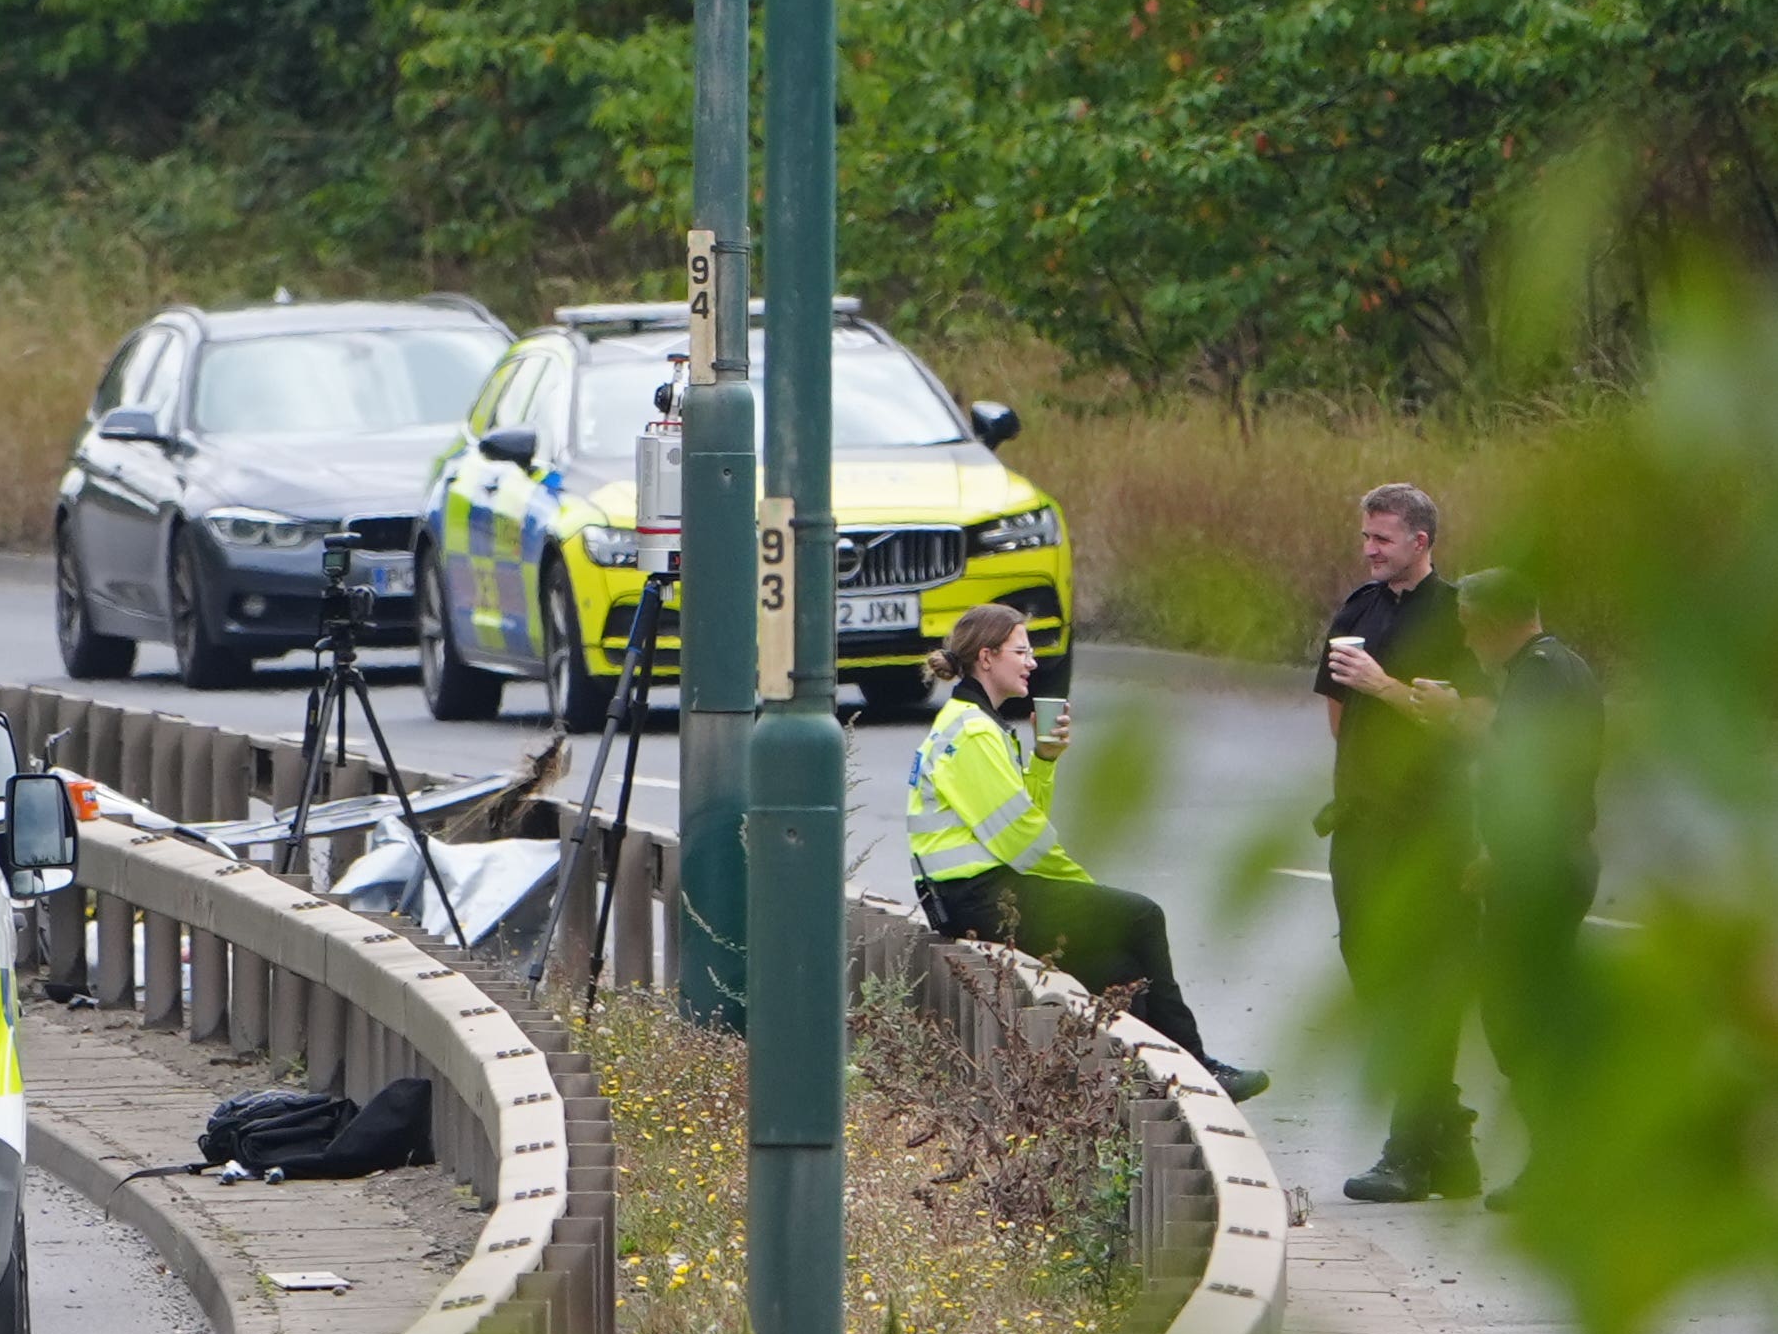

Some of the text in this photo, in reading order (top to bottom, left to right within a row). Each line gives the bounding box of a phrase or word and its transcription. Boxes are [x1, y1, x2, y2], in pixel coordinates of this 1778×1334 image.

[691, 255, 710, 320] 94
[761, 529, 786, 611] 93
[862, 602, 907, 624] JXN
